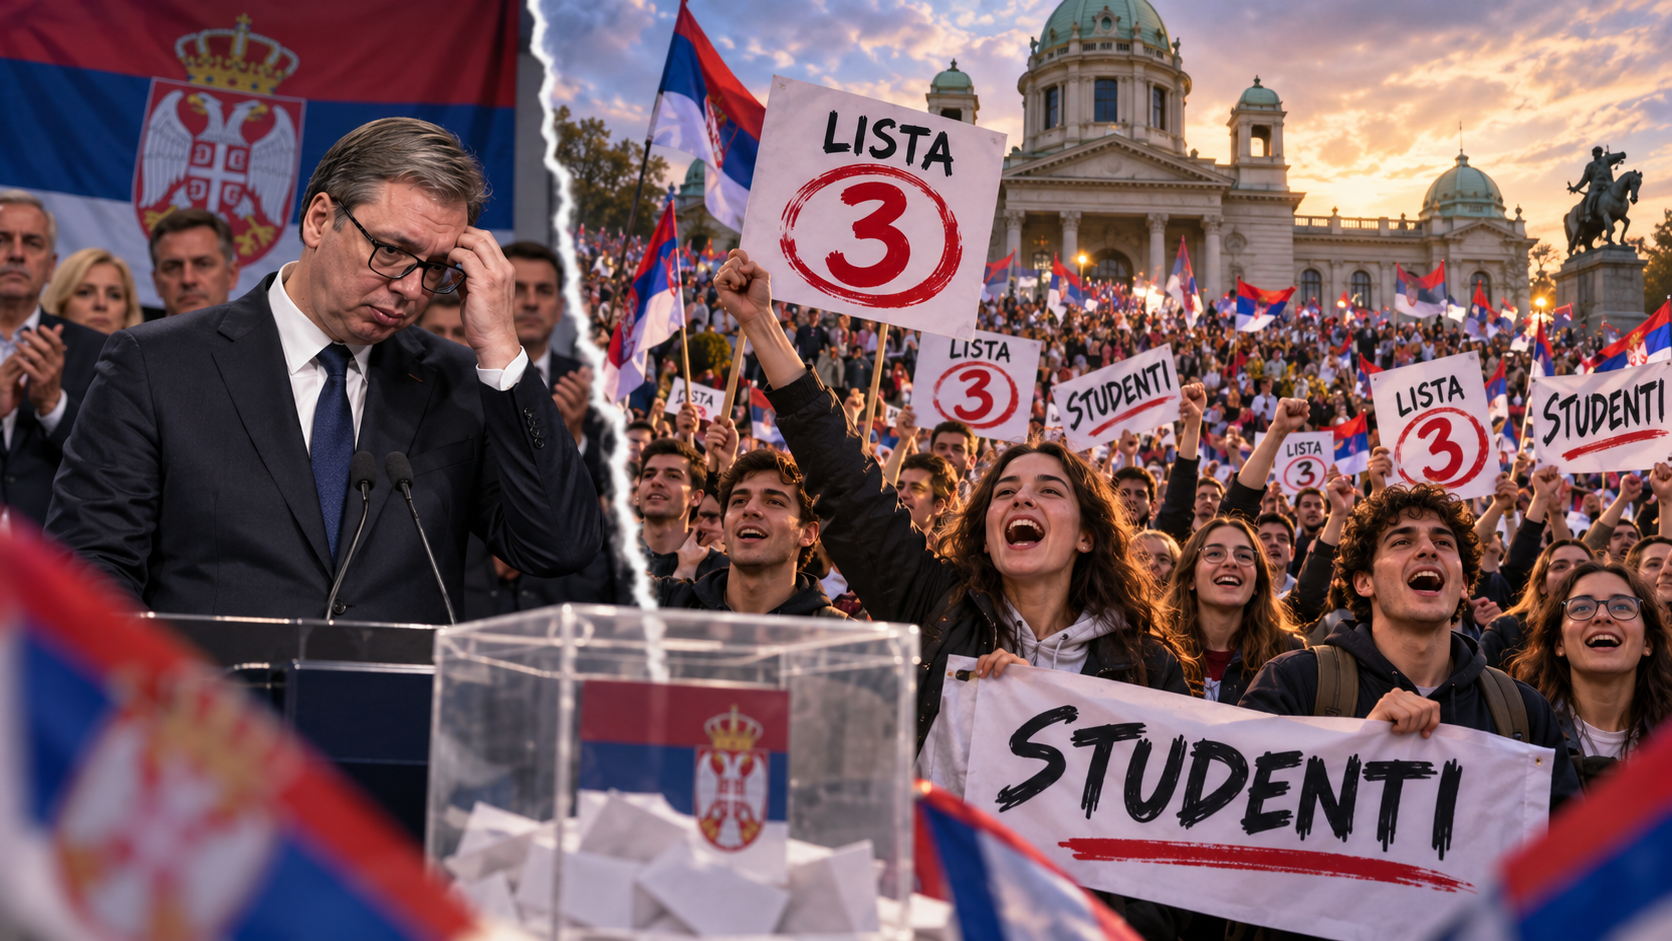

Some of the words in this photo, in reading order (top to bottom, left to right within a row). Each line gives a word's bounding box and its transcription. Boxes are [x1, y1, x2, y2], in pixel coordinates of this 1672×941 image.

[822, 110, 954, 177] LISTA
[825, 181, 911, 288] 3
[949, 338, 1011, 363] LISTA
[675, 389, 714, 408] LSTA
[953, 368, 994, 421] 3
[1066, 359, 1171, 431] STUDENTI
[1396, 375, 1465, 418] LISTA
[1542, 377, 1665, 447] STUDENTI
[1286, 440, 1323, 458] LISTA
[1296, 461, 1316, 486] 3
[1417, 417, 1464, 482] 3
[995, 704, 1463, 861] STUDENTI
